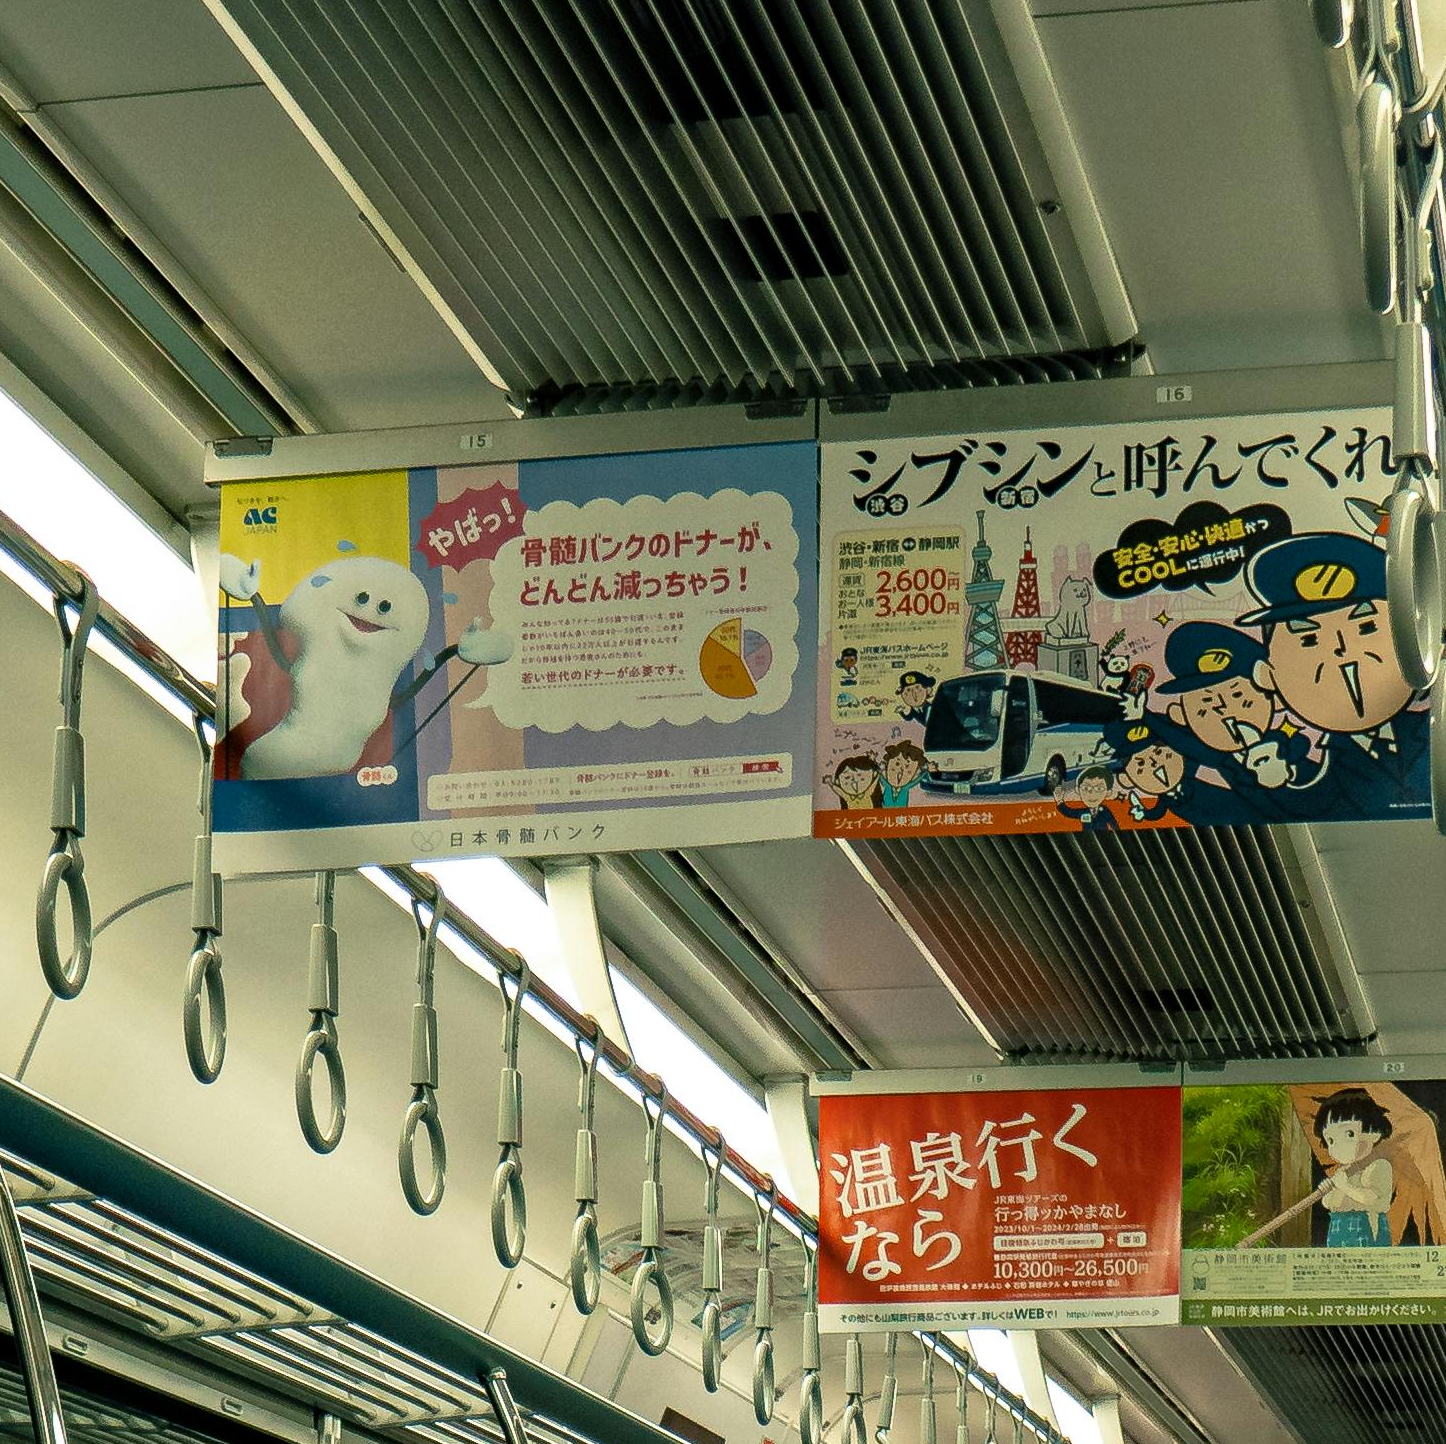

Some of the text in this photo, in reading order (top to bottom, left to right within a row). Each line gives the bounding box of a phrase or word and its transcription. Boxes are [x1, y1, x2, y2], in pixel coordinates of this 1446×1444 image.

[1165, 387, 1185, 401] 16
[469, 433, 486, 447] 15
[848, 425, 1395, 511] シブシンと呼んでくれ
[243, 507, 278, 525] AC
[427, 497, 518, 557] やばっ!
[243, 524, 278, 536] JAPAN
[520, 521, 774, 568] 骨髄バンクのドナーが、
[1113, 518, 1269, 569] 安全・安心・快適かつ
[520, 566, 749, 607] どんどん減っちゃう!
[875, 592, 959, 617] 3,400円
[450, 823, 605, 847] 日本骨髄バンク
[830, 1103, 1099, 1217] 温泉行く
[844, 1206, 963, 1282] なら
[1426, 1251, 1439, 1262] 12
[1211, 1303, 1436, 1318] 静岡市美術館へは、JRでお出かけください。
